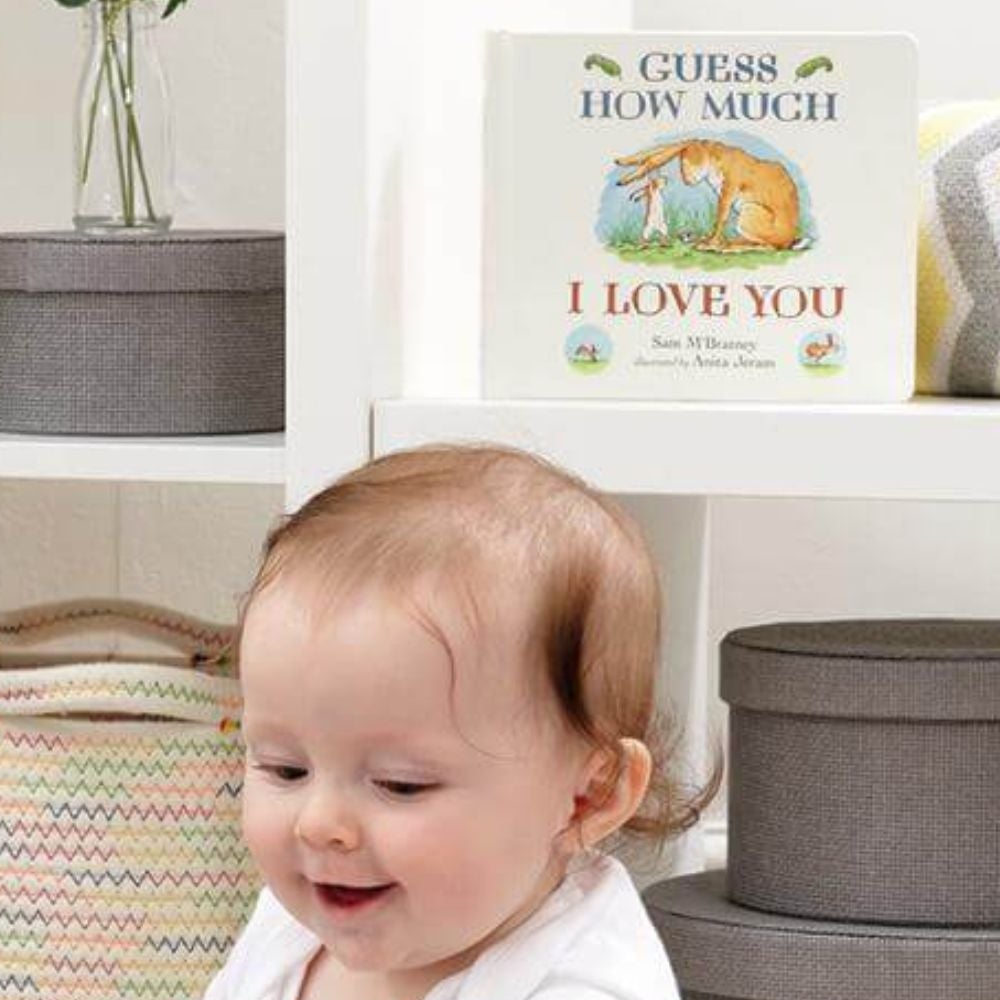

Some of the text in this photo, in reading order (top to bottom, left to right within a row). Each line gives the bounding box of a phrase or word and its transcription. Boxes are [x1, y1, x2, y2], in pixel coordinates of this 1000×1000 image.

[638, 53, 779, 84] GUESS
[579, 89, 839, 122] HOW MUCH
[567, 281, 848, 319] I LOVE YOU
